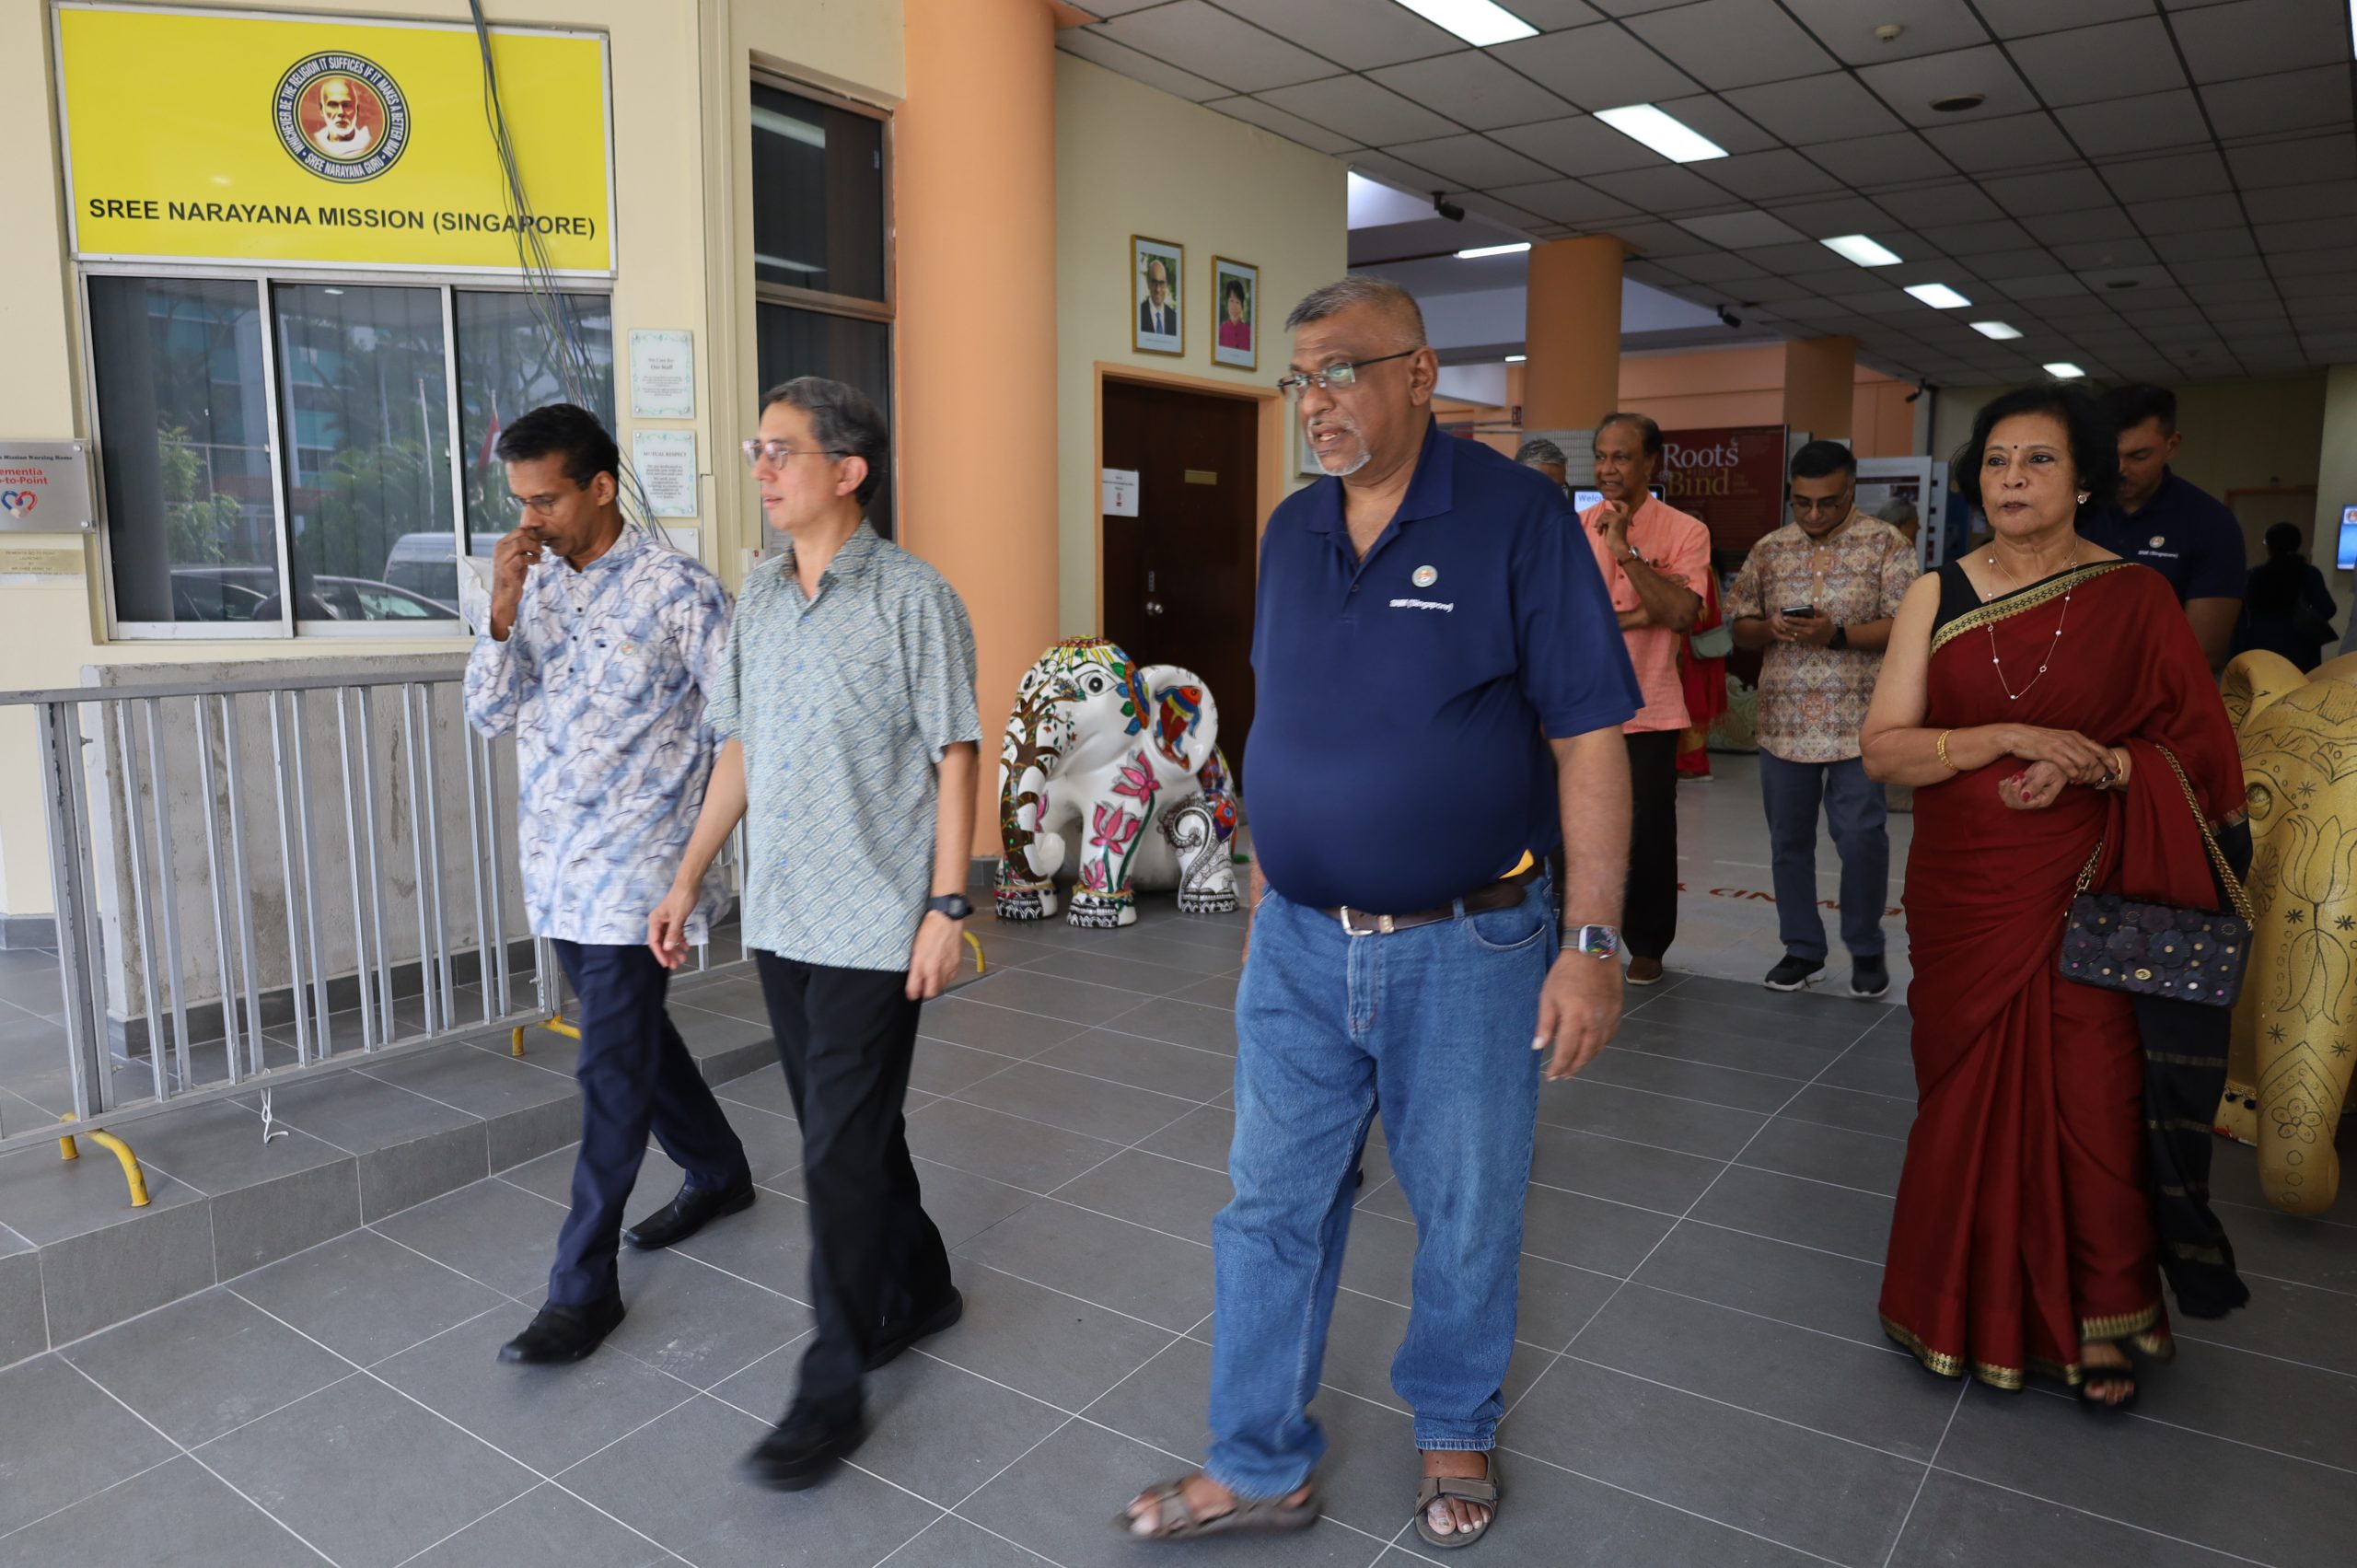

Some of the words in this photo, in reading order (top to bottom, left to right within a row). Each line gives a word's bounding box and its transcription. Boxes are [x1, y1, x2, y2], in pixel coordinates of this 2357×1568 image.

[319, 57, 329, 71] IT
[328, 56, 366, 75] SUFFICES
[363, 65, 374, 78] IF
[289, 60, 321, 88] RELIGION
[370, 71, 381, 84] IT
[282, 84, 297, 99] THE
[376, 80, 400, 105] MAKES
[279, 99, 293, 110] BE
[279, 111, 305, 155] WHICHEVER
[391, 111, 404, 141] BETTER
[382, 140, 400, 158] MAN
[304, 152, 326, 171] SREE
[324, 163, 366, 178] NARAYANA
[363, 156, 384, 174] GURU
[89, 199, 160, 220] SREE
[168, 202, 312, 226] NARAYANA
[319, 207, 424, 229] MISSION
[433, 212, 596, 240] (SINGAPORE)
[1662, 443, 1738, 470] Roots
[0, 467, 43, 475] ementia
[0, 476, 48, 484] -to-Point
[1667, 467, 1730, 496] Bind
